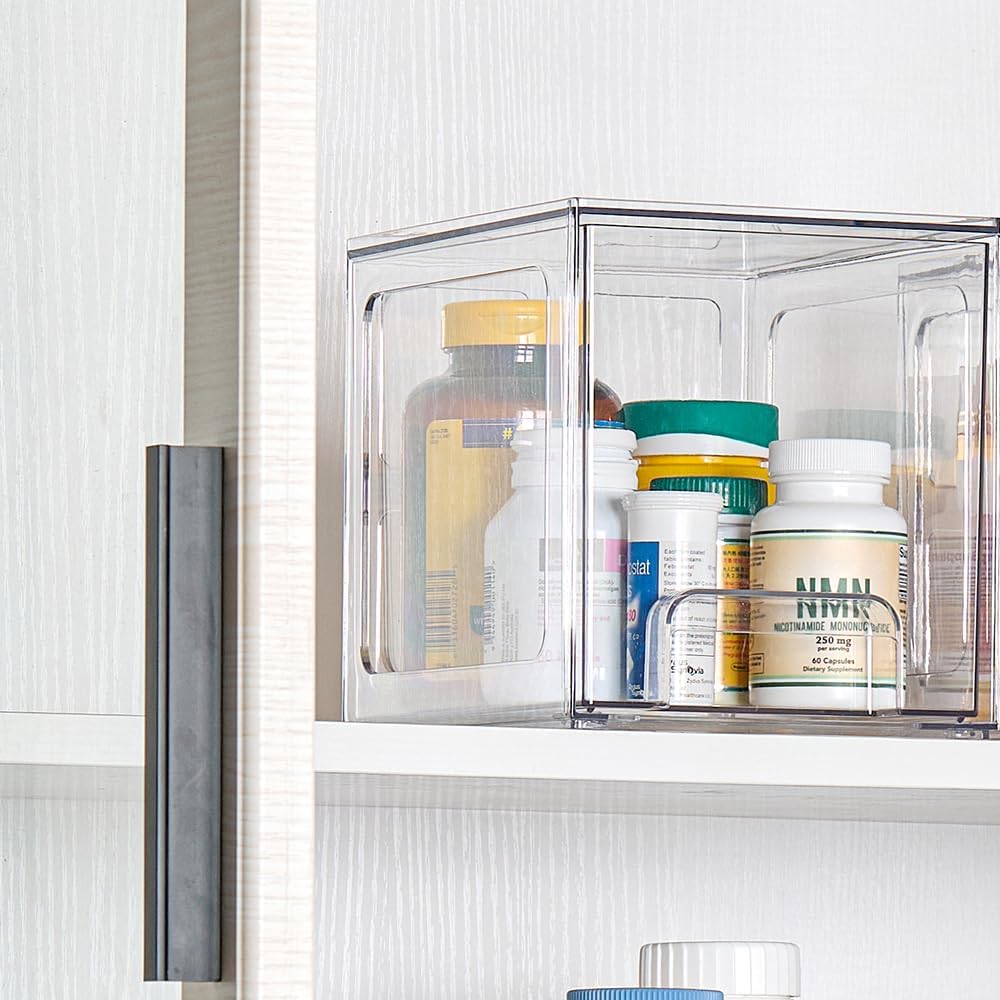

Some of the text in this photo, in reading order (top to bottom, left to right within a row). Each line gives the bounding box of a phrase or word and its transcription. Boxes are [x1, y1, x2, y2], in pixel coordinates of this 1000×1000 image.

[796, 577, 871, 619] NMN
[774, 621, 825, 632] NICOTINAMIDE
[816, 636, 852, 647] 250 mg
[823, 658, 855, 666] Capsules
